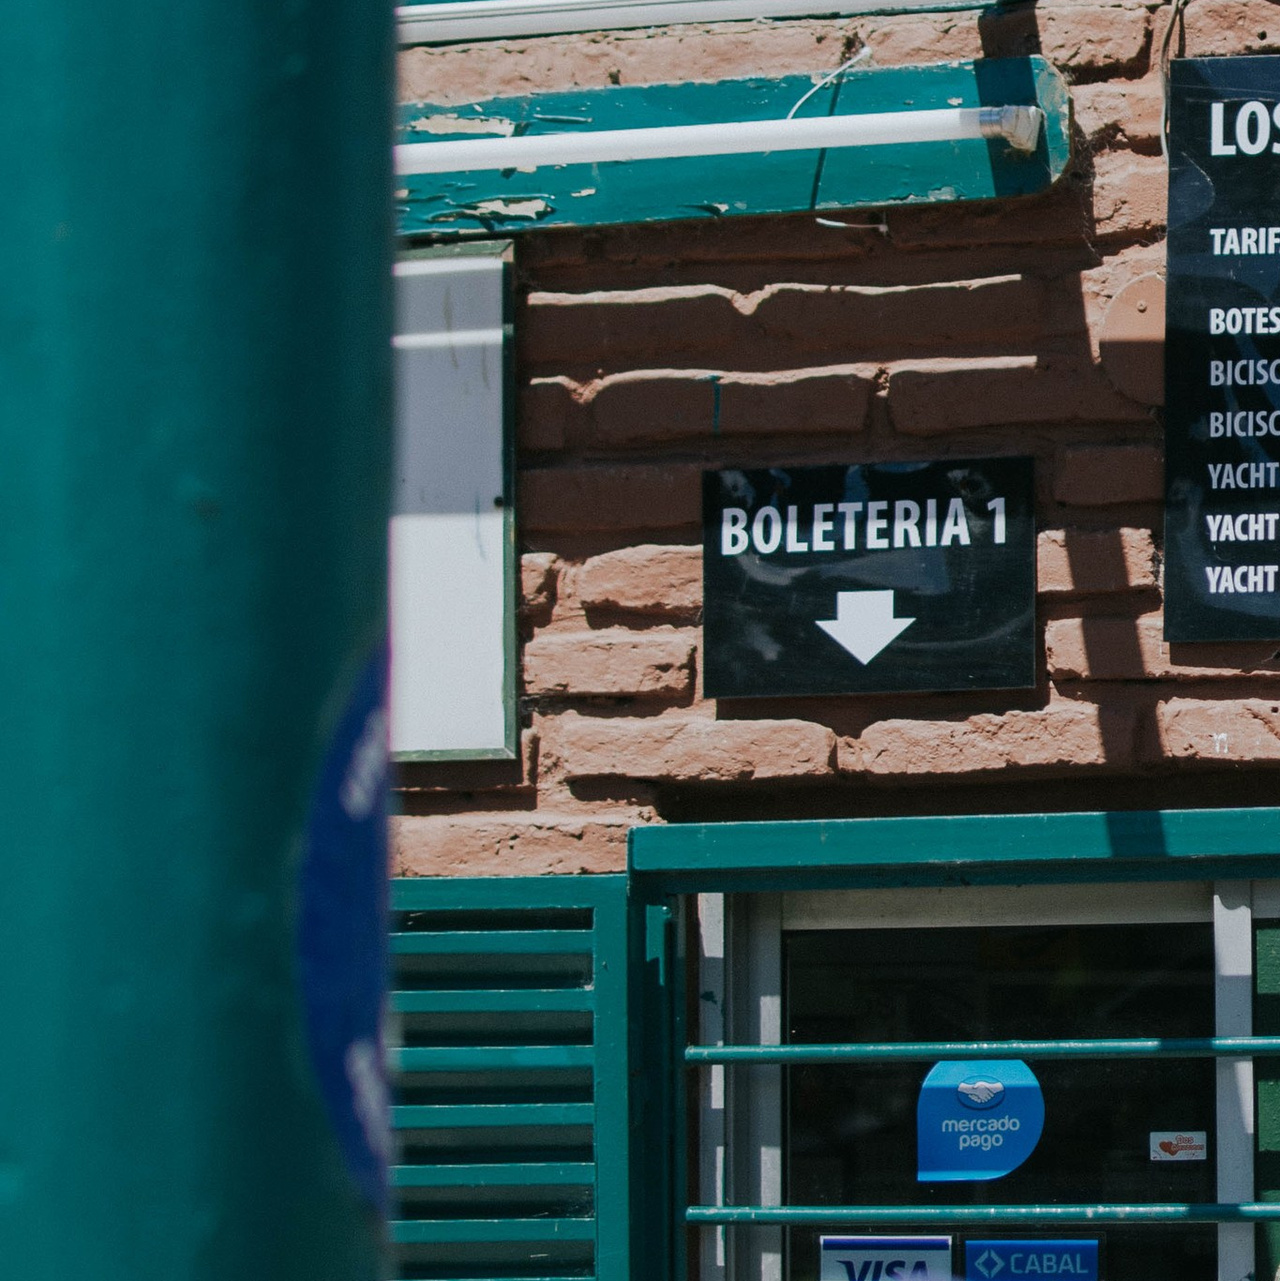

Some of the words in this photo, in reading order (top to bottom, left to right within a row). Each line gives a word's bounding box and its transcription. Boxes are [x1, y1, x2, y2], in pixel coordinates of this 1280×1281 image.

[1207, 462, 1279, 489] YACHT
[721, 497, 971, 556] BOLETERIA
[987, 496, 1006, 545] 1
[1206, 513, 1279, 541] YACHT
[1205, 565, 1279, 594] YACHT
[942, 1115, 1020, 1132] mercado
[960, 1133, 1003, 1151] pago
[1010, 1253, 1089, 1274] CABAL
